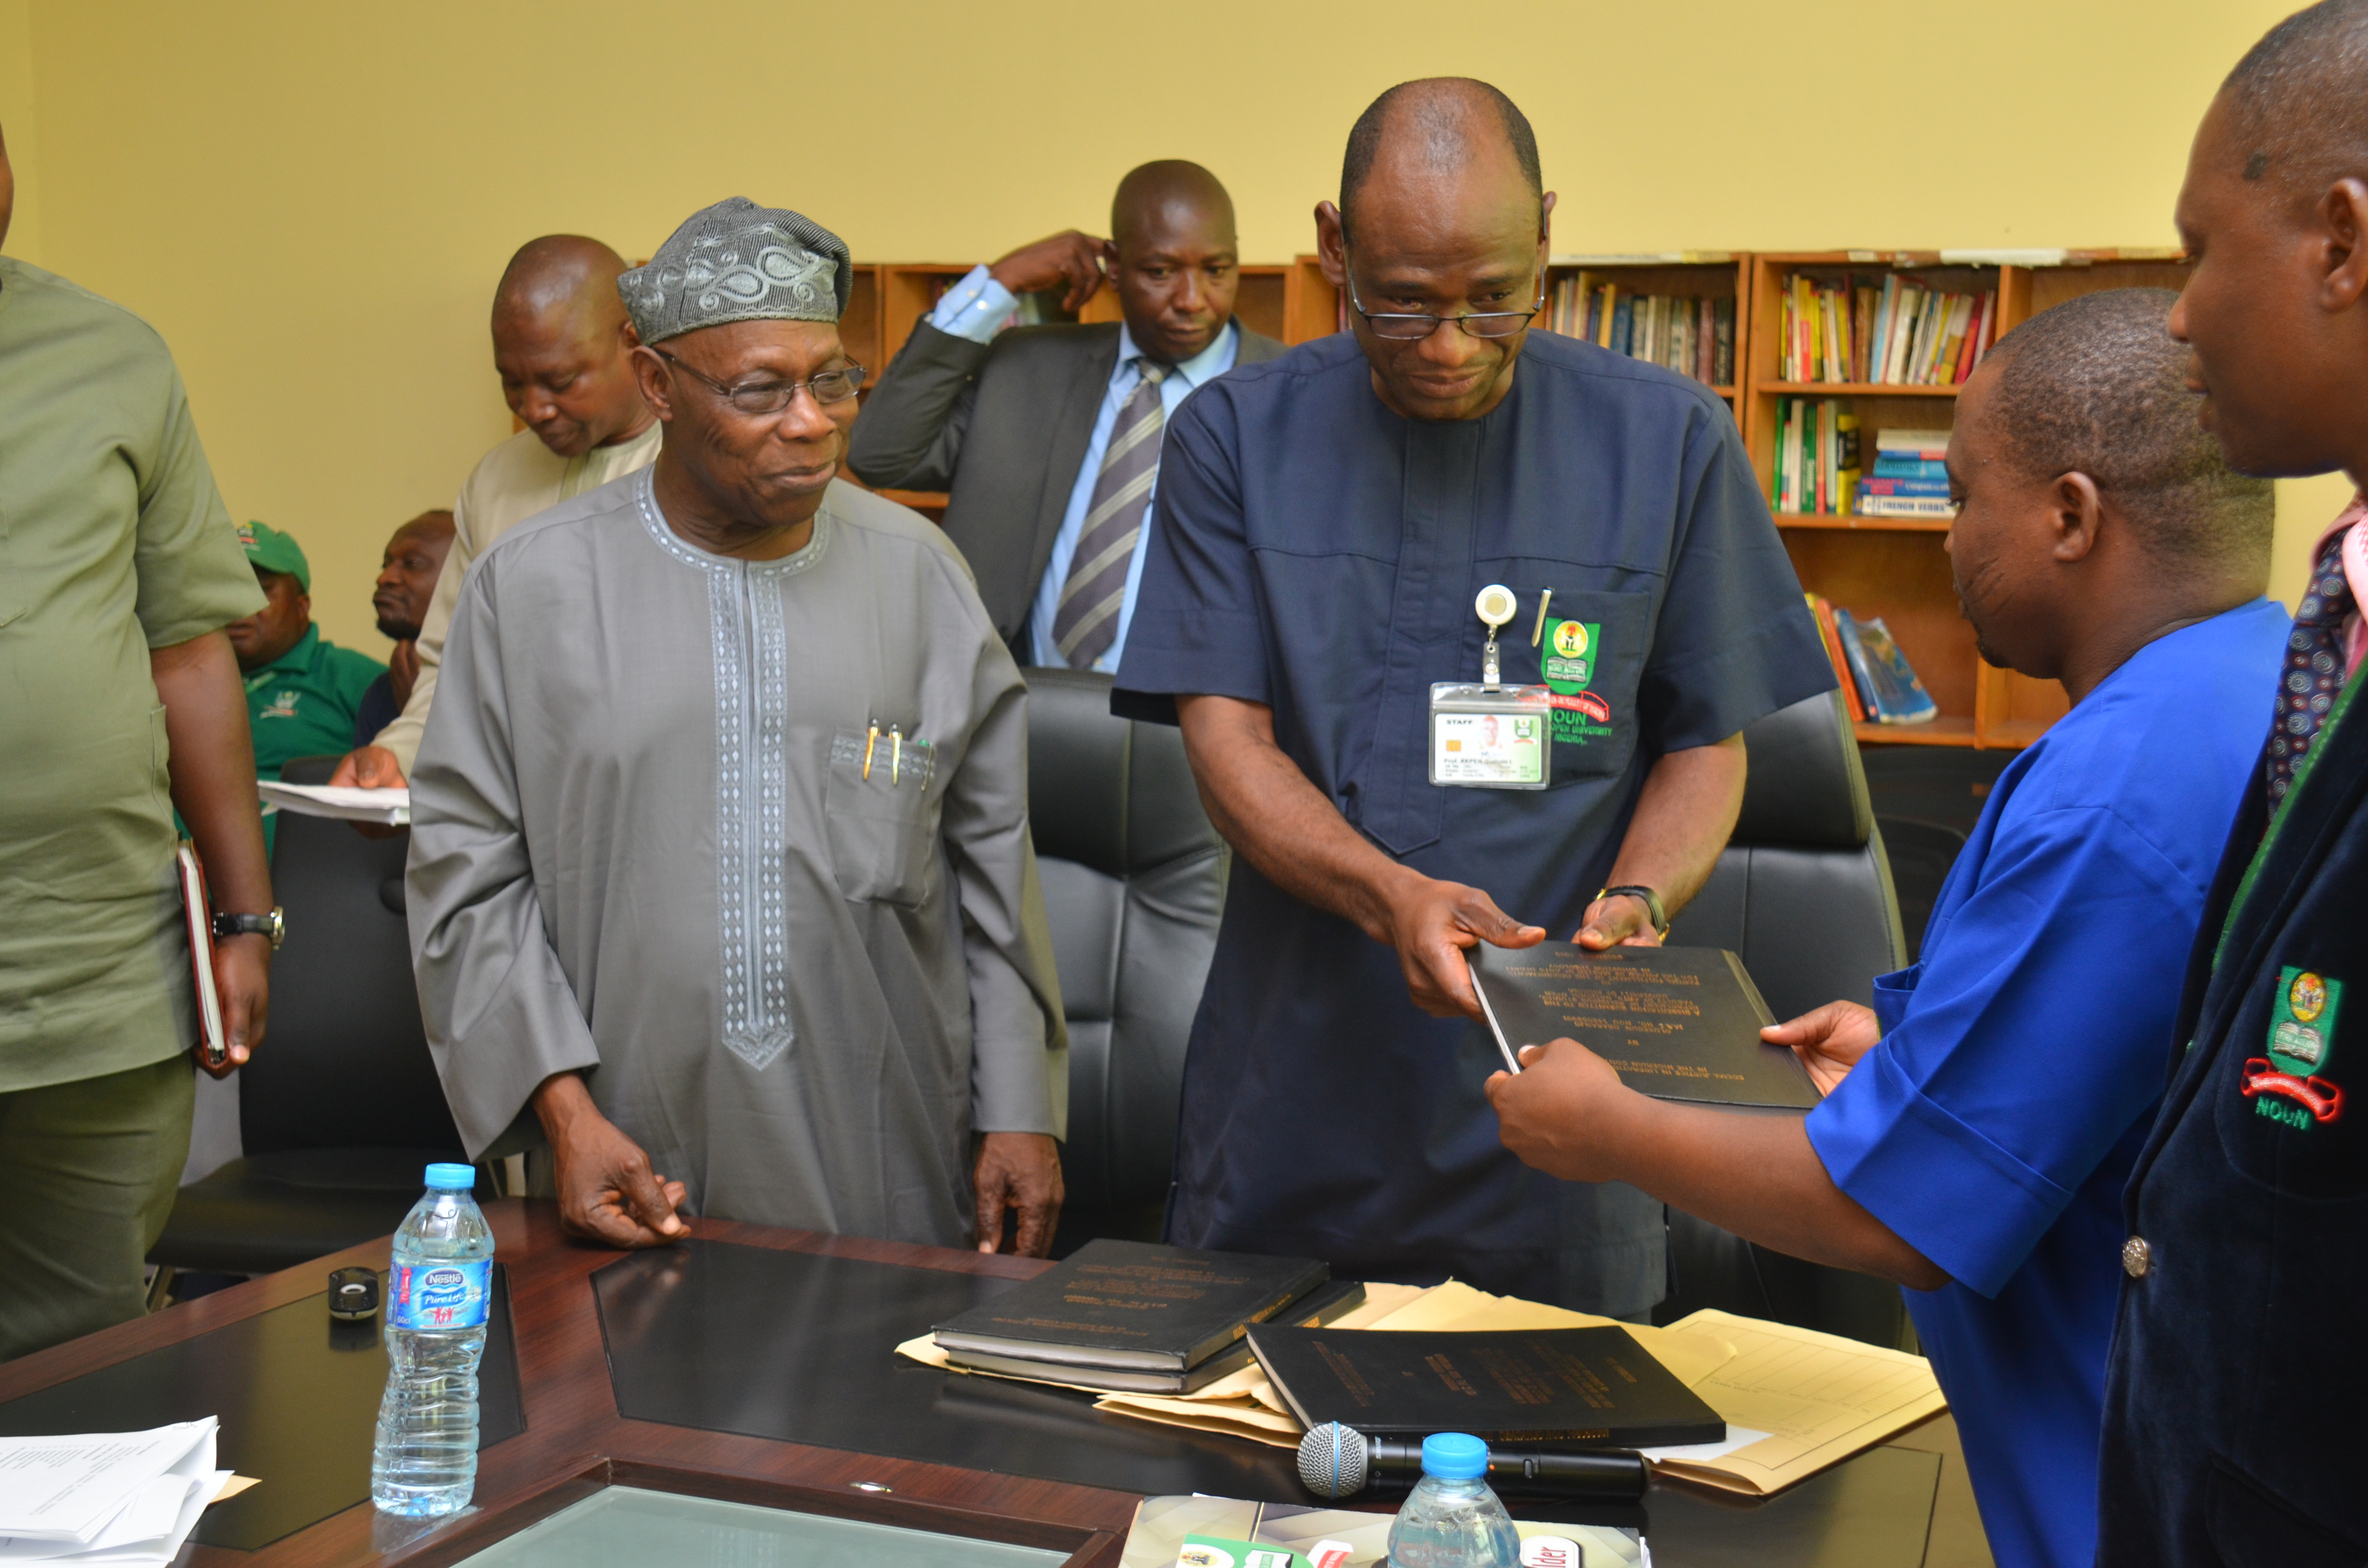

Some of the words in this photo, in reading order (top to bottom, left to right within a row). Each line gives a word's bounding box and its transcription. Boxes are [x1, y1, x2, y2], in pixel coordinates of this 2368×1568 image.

[1610, 1065, 1657, 1073] LIBERATIO
[2256, 1096, 2310, 1130] NOUN
[424, 1294, 446, 1306] Pure
[397, 1315, 411, 1325] 60cl
